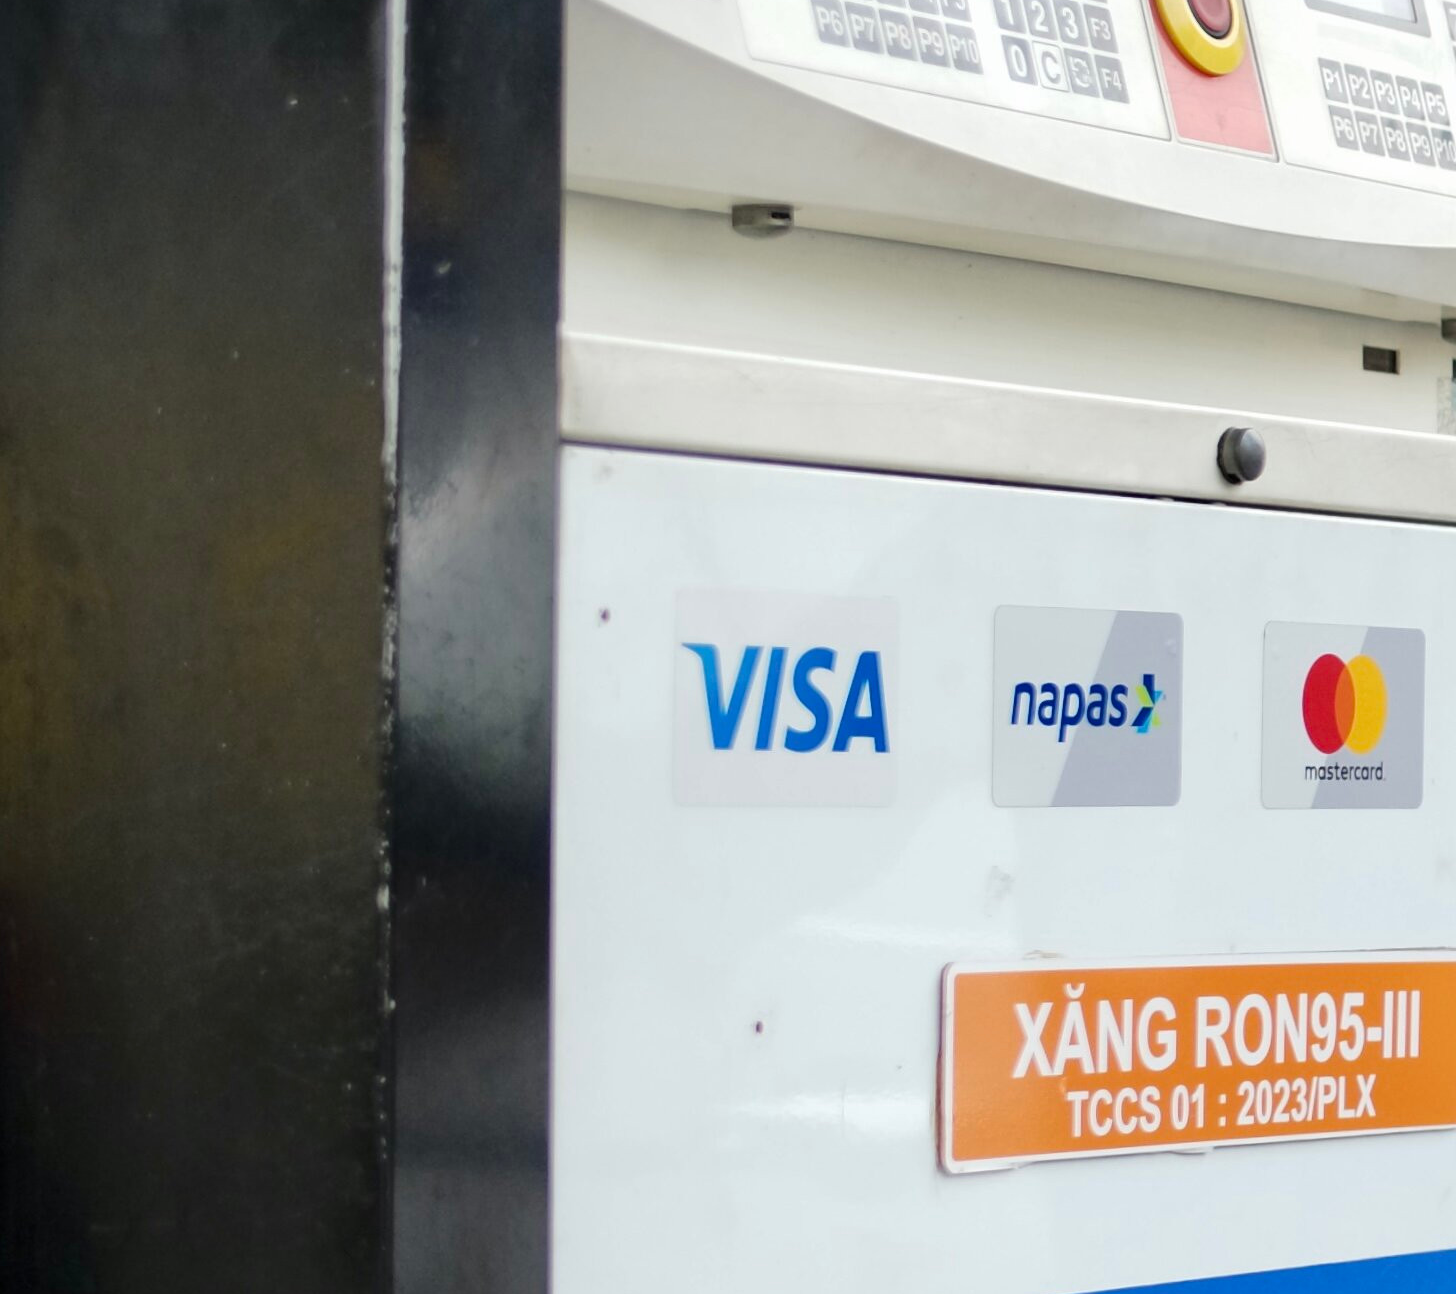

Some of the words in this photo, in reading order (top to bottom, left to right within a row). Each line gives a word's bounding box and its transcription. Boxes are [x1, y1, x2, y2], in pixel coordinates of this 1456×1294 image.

[816, 6, 844, 37] P6
[850, 13, 875, 43] P7
[884, 20, 912, 51] P8
[918, 27, 945, 57] P9
[949, 34, 980, 65] P10
[1031, 0, 1049, 33] 2
[1062, 7, 1079, 40] 3
[1089, 17, 1112, 41] F3
[1010, 44, 1028, 78] 0
[1040, 49, 1062, 85] C
[1101, 68, 1123, 92] F4
[1321, 67, 1343, 93] P1
[1348, 73, 1371, 100] P2
[1374, 80, 1396, 106] P3
[1399, 86, 1422, 112] P4
[1424, 91, 1447, 117] P5
[1332, 114, 1355, 141] P6
[1358, 121, 1379, 146] P7
[1384, 126, 1406, 153] P8
[1409, 132, 1432, 158] P9
[680, 642, 892, 754] VISA
[1010, 680, 1131, 743] napas
[1304, 761, 1384, 782] mastercard
[1012, 982, 1178, 1079] XĂNG
[1195, 990, 1421, 1068] RON95-III
[1067, 1085, 1161, 1138] TCCS
[1170, 1083, 1205, 1129] 01
[1218, 1092, 1227, 1127] :
[1237, 1073, 1377, 1126] 2023/PLX
